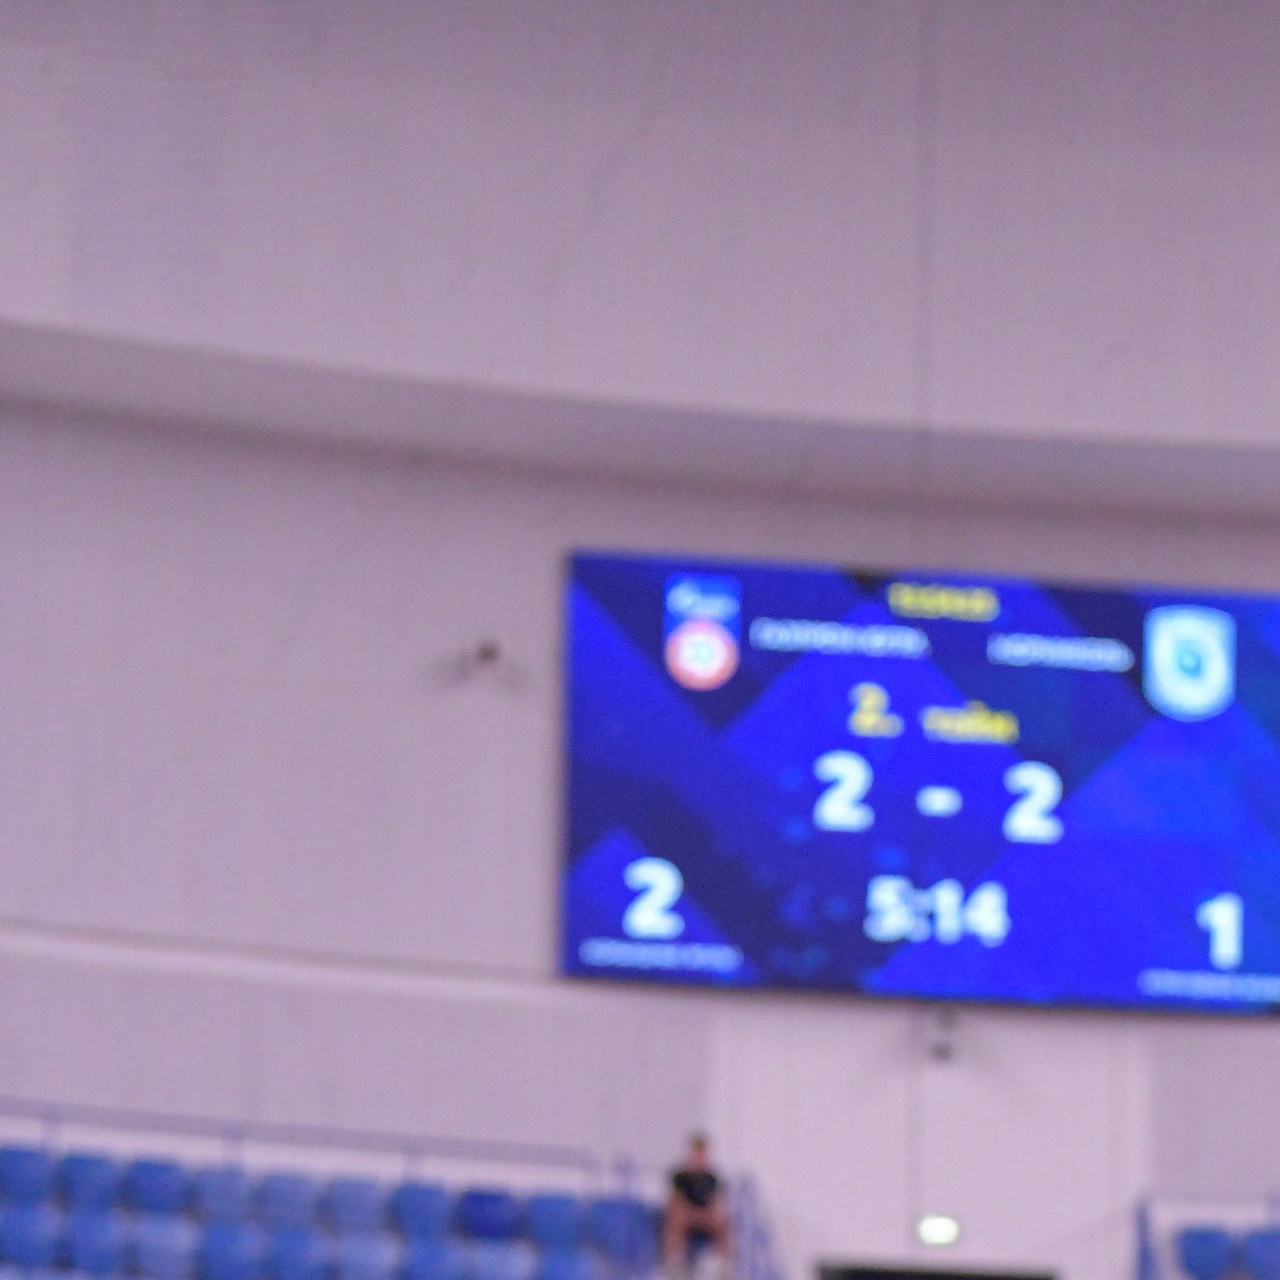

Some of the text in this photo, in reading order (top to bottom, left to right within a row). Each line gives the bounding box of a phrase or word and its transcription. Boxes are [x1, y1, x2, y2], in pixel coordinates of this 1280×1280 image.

[813, 750, 875, 832] 2
[1003, 761, 1064, 845] 2
[622, 857, 685, 939] 2
[863, 874, 1011, 948] 5:14
[1196, 892, 1245, 970] 1
